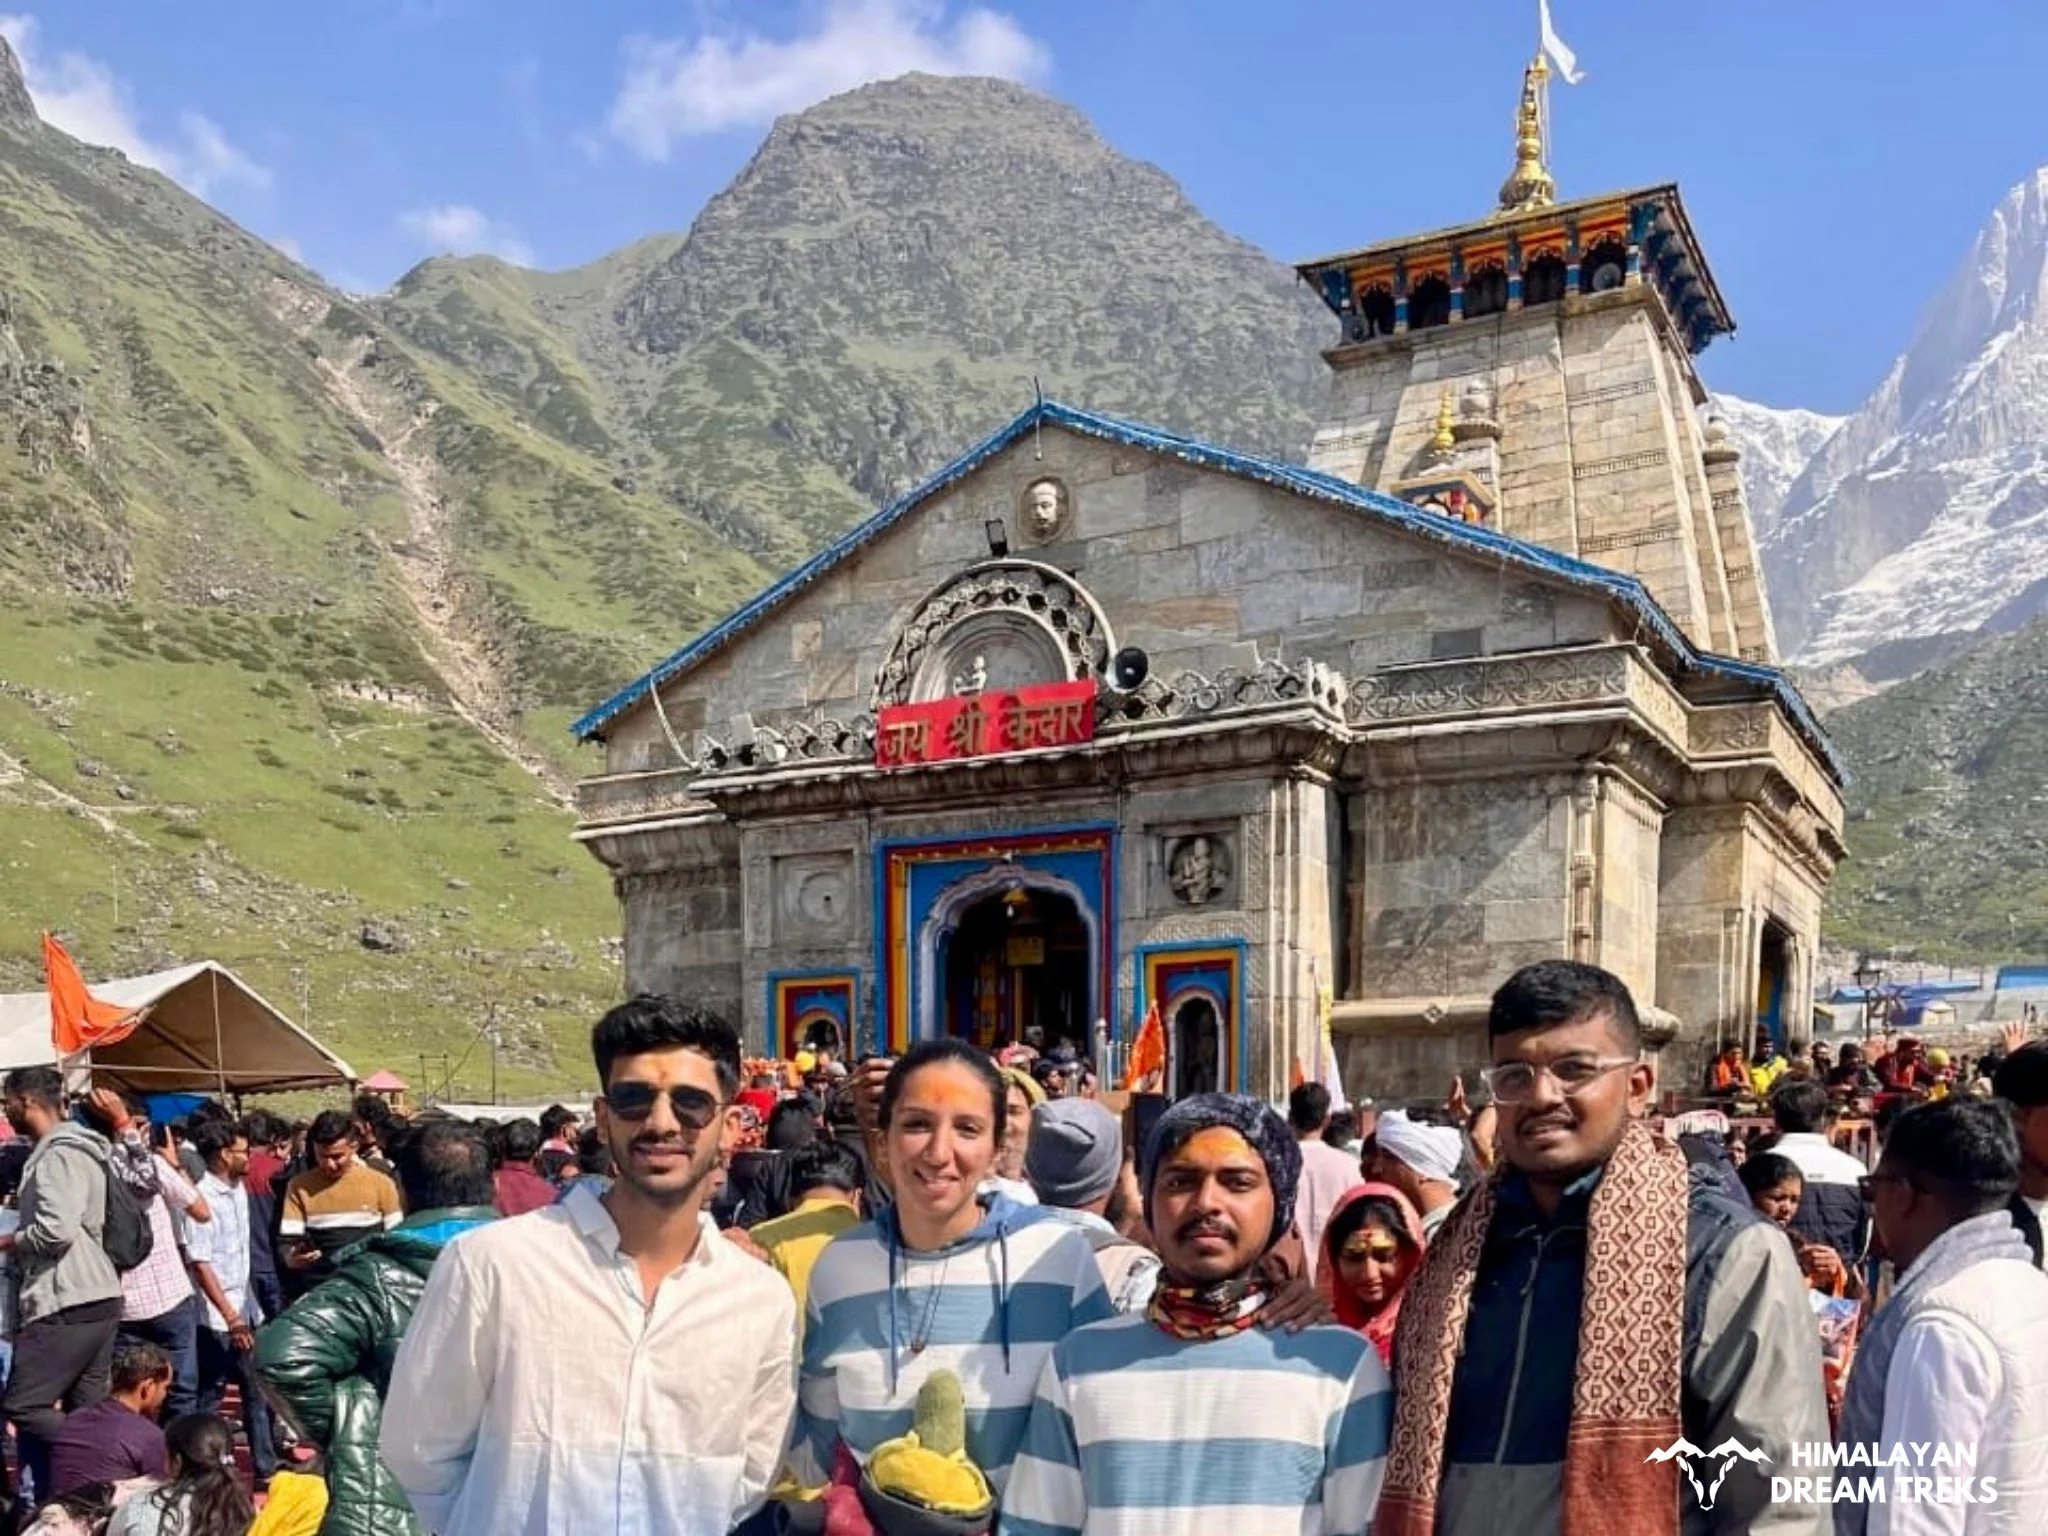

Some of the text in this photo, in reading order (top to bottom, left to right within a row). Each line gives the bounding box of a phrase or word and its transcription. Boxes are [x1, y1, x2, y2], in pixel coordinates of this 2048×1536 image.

[884, 696, 1086, 761] जय श्री केदार
